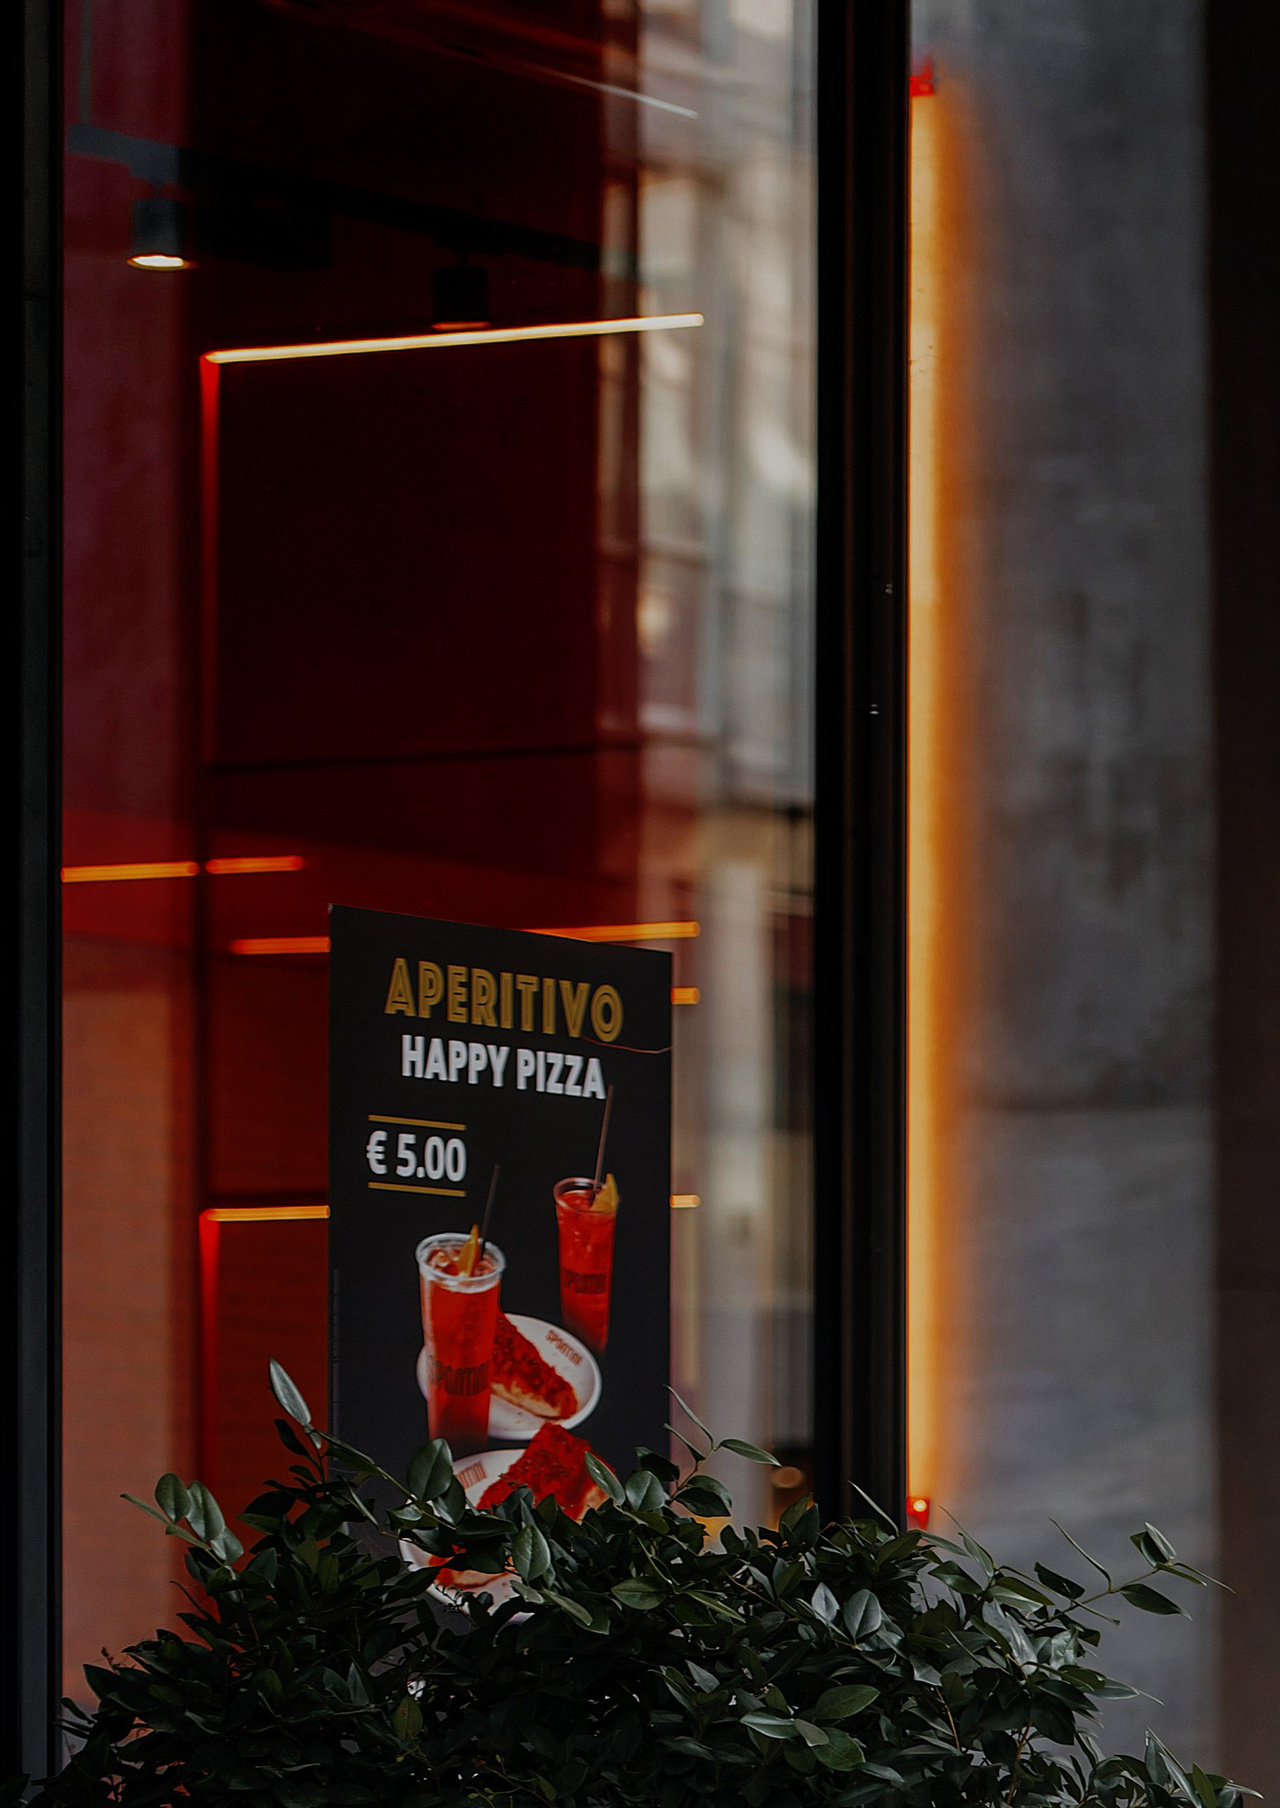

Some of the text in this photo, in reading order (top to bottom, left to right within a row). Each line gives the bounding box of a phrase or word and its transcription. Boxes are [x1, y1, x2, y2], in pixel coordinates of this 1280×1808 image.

[385, 957, 623, 1043] APERITIVO
[401, 1034, 607, 1101] HAPPY PIZZA
[366, 1130, 467, 1183] € 5.00
